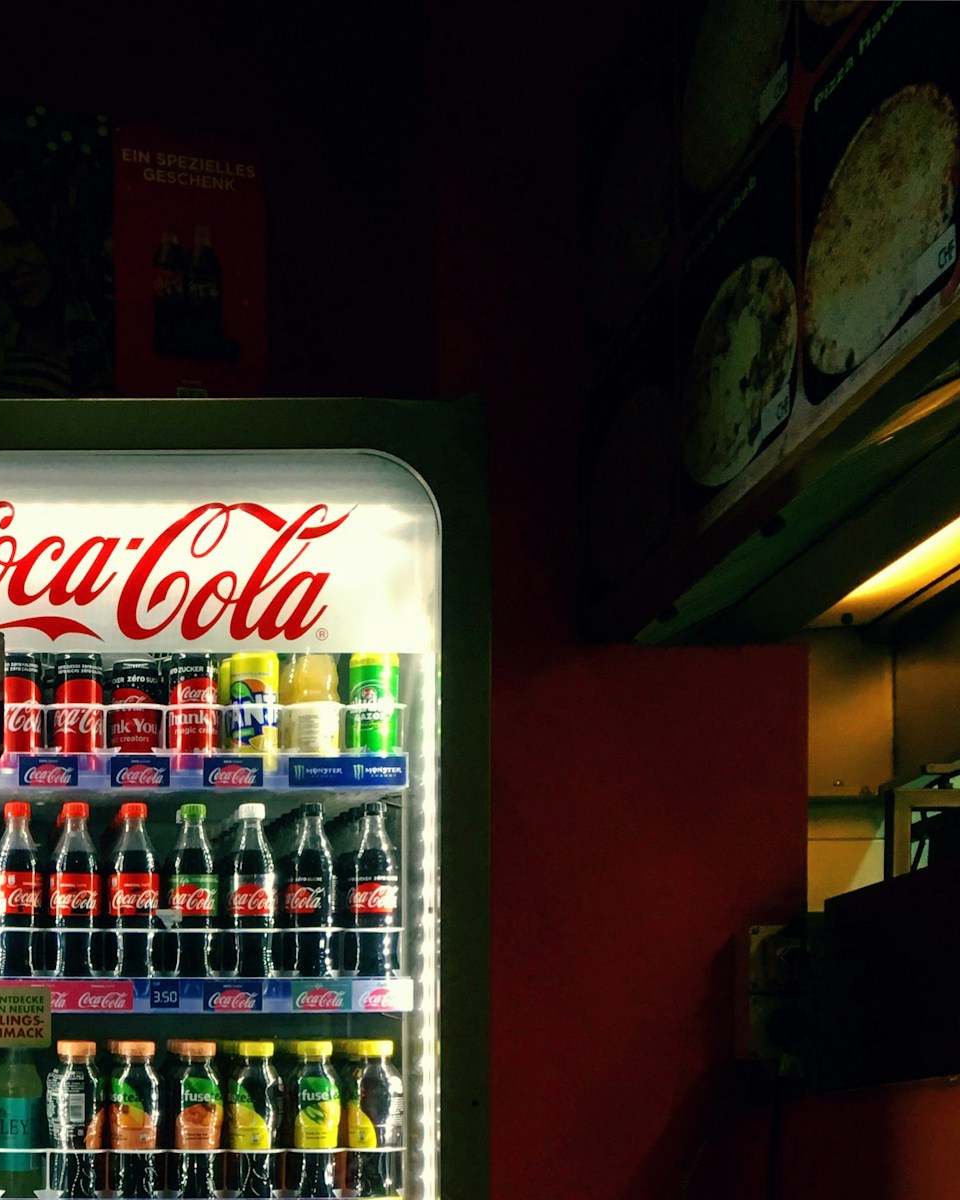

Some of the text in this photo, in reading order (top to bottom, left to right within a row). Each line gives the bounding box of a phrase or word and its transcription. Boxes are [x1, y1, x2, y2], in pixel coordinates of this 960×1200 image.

[122, 147, 256, 179] EIN SPEZIELLES
[143, 167, 237, 192] GESCHENK
[24, 767, 74, 784] Coca-Cola
[116, 767, 166, 785] Coca-Cola
[208, 767, 259, 784] Coca-Cola
[50, 889, 98, 910] Coca-Cola
[78, 991, 127, 1009] Coca-Cola
[208, 991, 258, 1009] Coca-Cola
[295, 991, 344, 1009] Coca-Cola
[9, 1005, 44, 1014] NEUEN
